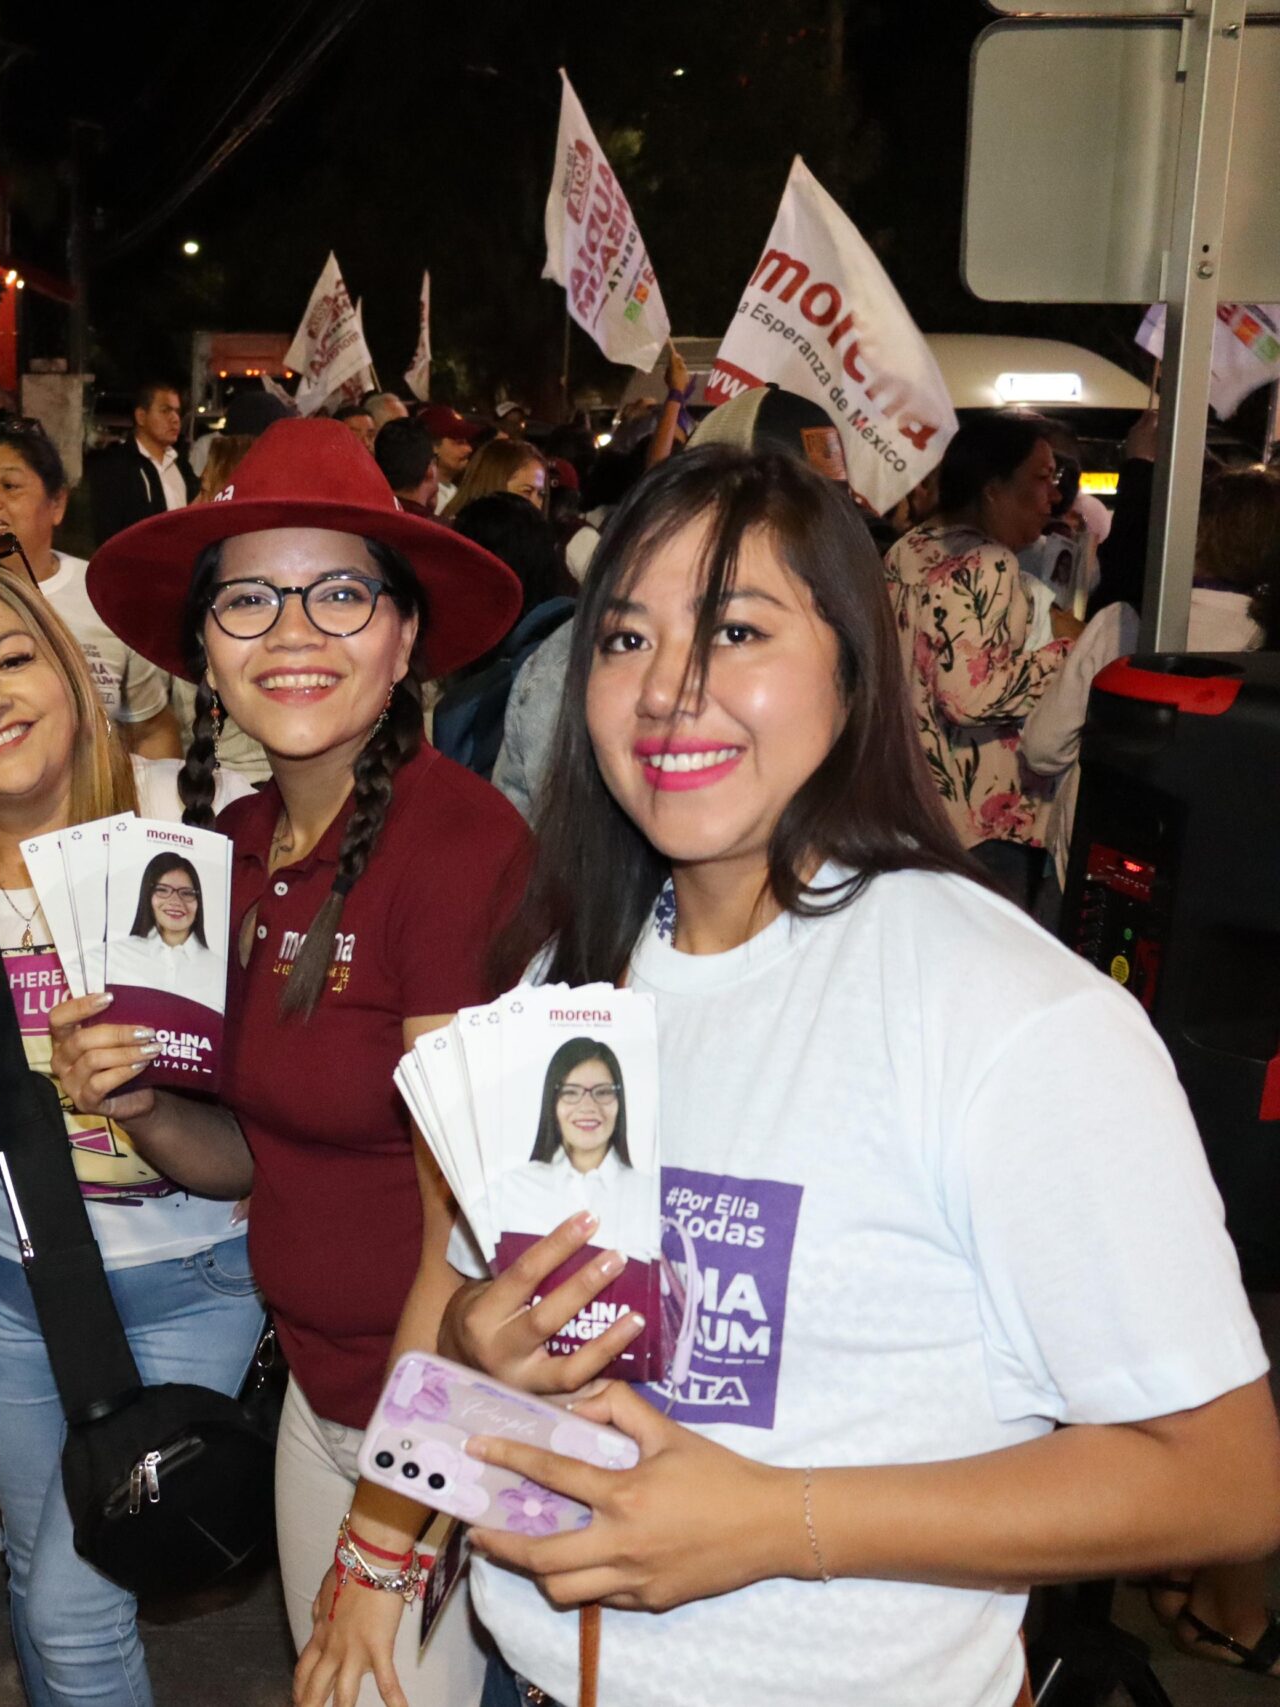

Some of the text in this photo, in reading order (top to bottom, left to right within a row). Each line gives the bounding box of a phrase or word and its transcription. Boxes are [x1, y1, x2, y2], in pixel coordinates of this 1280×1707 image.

[750, 303, 832, 386] Esperanza
[829, 389, 850, 413] de
[847, 409, 907, 473] México
[146, 829, 194, 846] morena
[279, 931, 355, 962] mna
[549, 1009, 612, 1022] morena
[155, 1029, 212, 1052] OLINA
[161, 1042, 203, 1062] GEL
[153, 1060, 199, 1073] UTADA
[666, 1187, 760, 1219] #Por Ella
[675, 1209, 766, 1249] Todas
[557, 1319, 612, 1340] NGE
